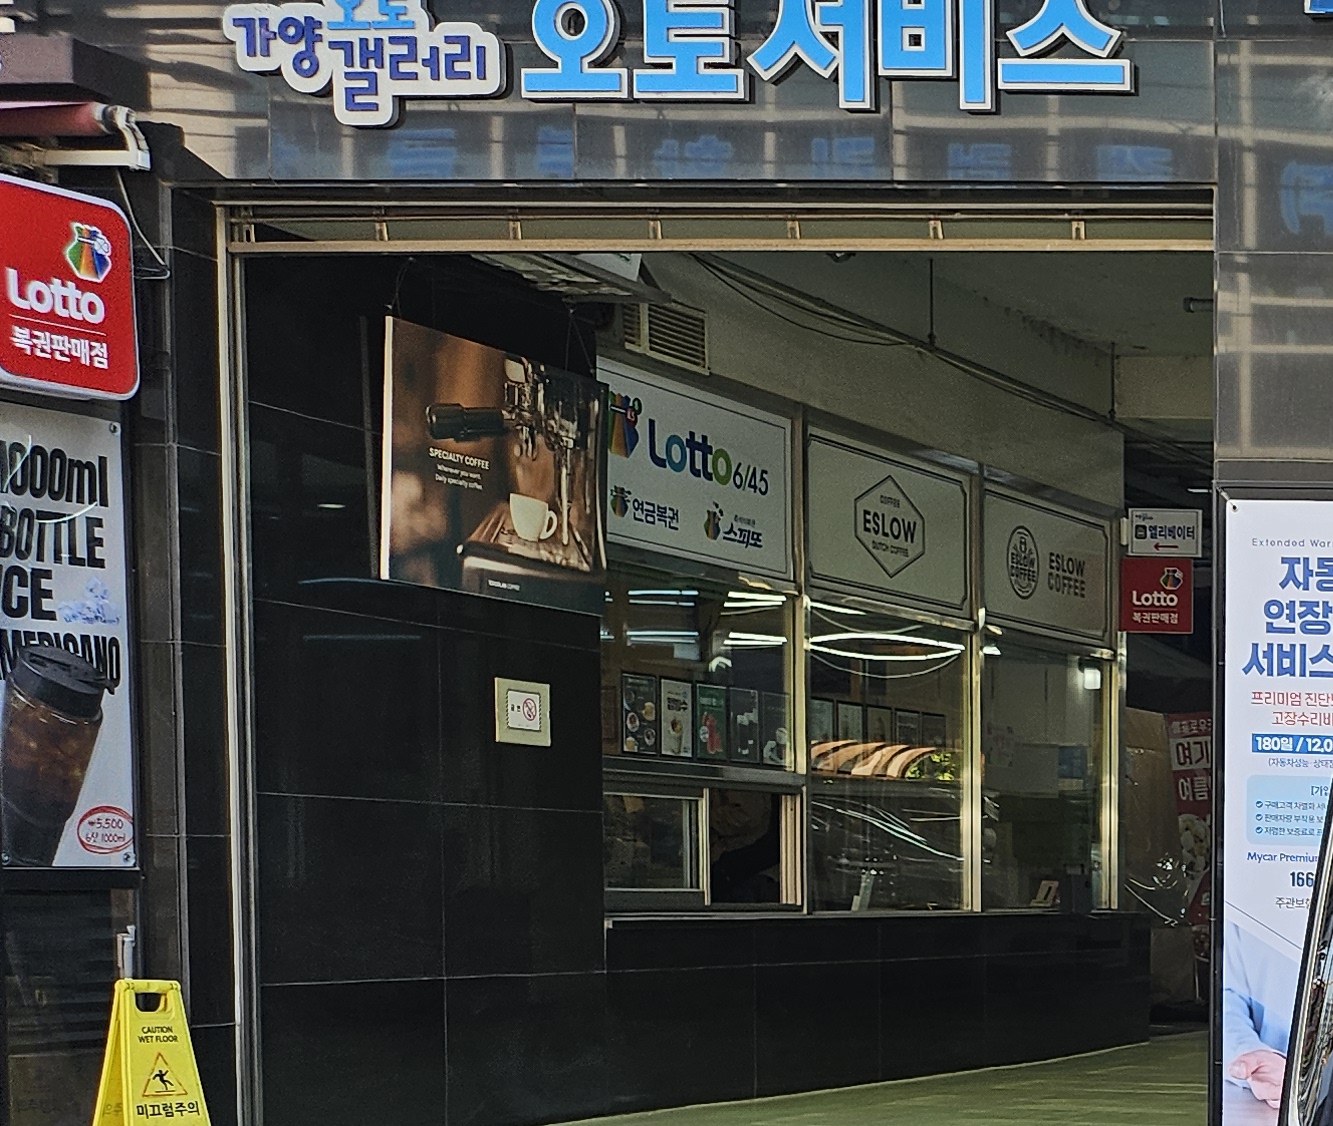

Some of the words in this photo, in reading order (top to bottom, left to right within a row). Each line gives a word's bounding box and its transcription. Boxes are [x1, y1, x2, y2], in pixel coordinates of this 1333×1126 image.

[232, 15, 323, 78] 가양
[327, 35, 487, 112] 갤러리
[5, 266, 105, 325] Lotto
[9, 325, 109, 370] 복권판매점
[428, 446, 465, 464] SPECIALTY
[464, 455, 490, 471] COFFEE
[647, 417, 733, 486] Lotto
[732, 461, 769, 497] 6/45
[631, 497, 680, 531] 연금복권
[862, 508, 917, 544] ESLOW
[1251, 538, 1306, 549] Extended
[1048, 551, 1086, 578] ESLOW
[0, 563, 58, 622] CE
[1047, 571, 1087, 599] COFFEE
[1131, 590, 1179, 607] Lotto
[1131, 611, 1179, 625] 복권판매점
[1251, 691, 1302, 707] 프리미엄
[1255, 736, 1294, 751] 180일
[1247, 851, 1278, 863] Mycar
[137, 1035, 154, 1044] WET
[155, 1034, 179, 1043] FLOOR
[141, 1025, 174, 1035] CAUTION
[135, 1100, 201, 1120] 미끄럼주의
